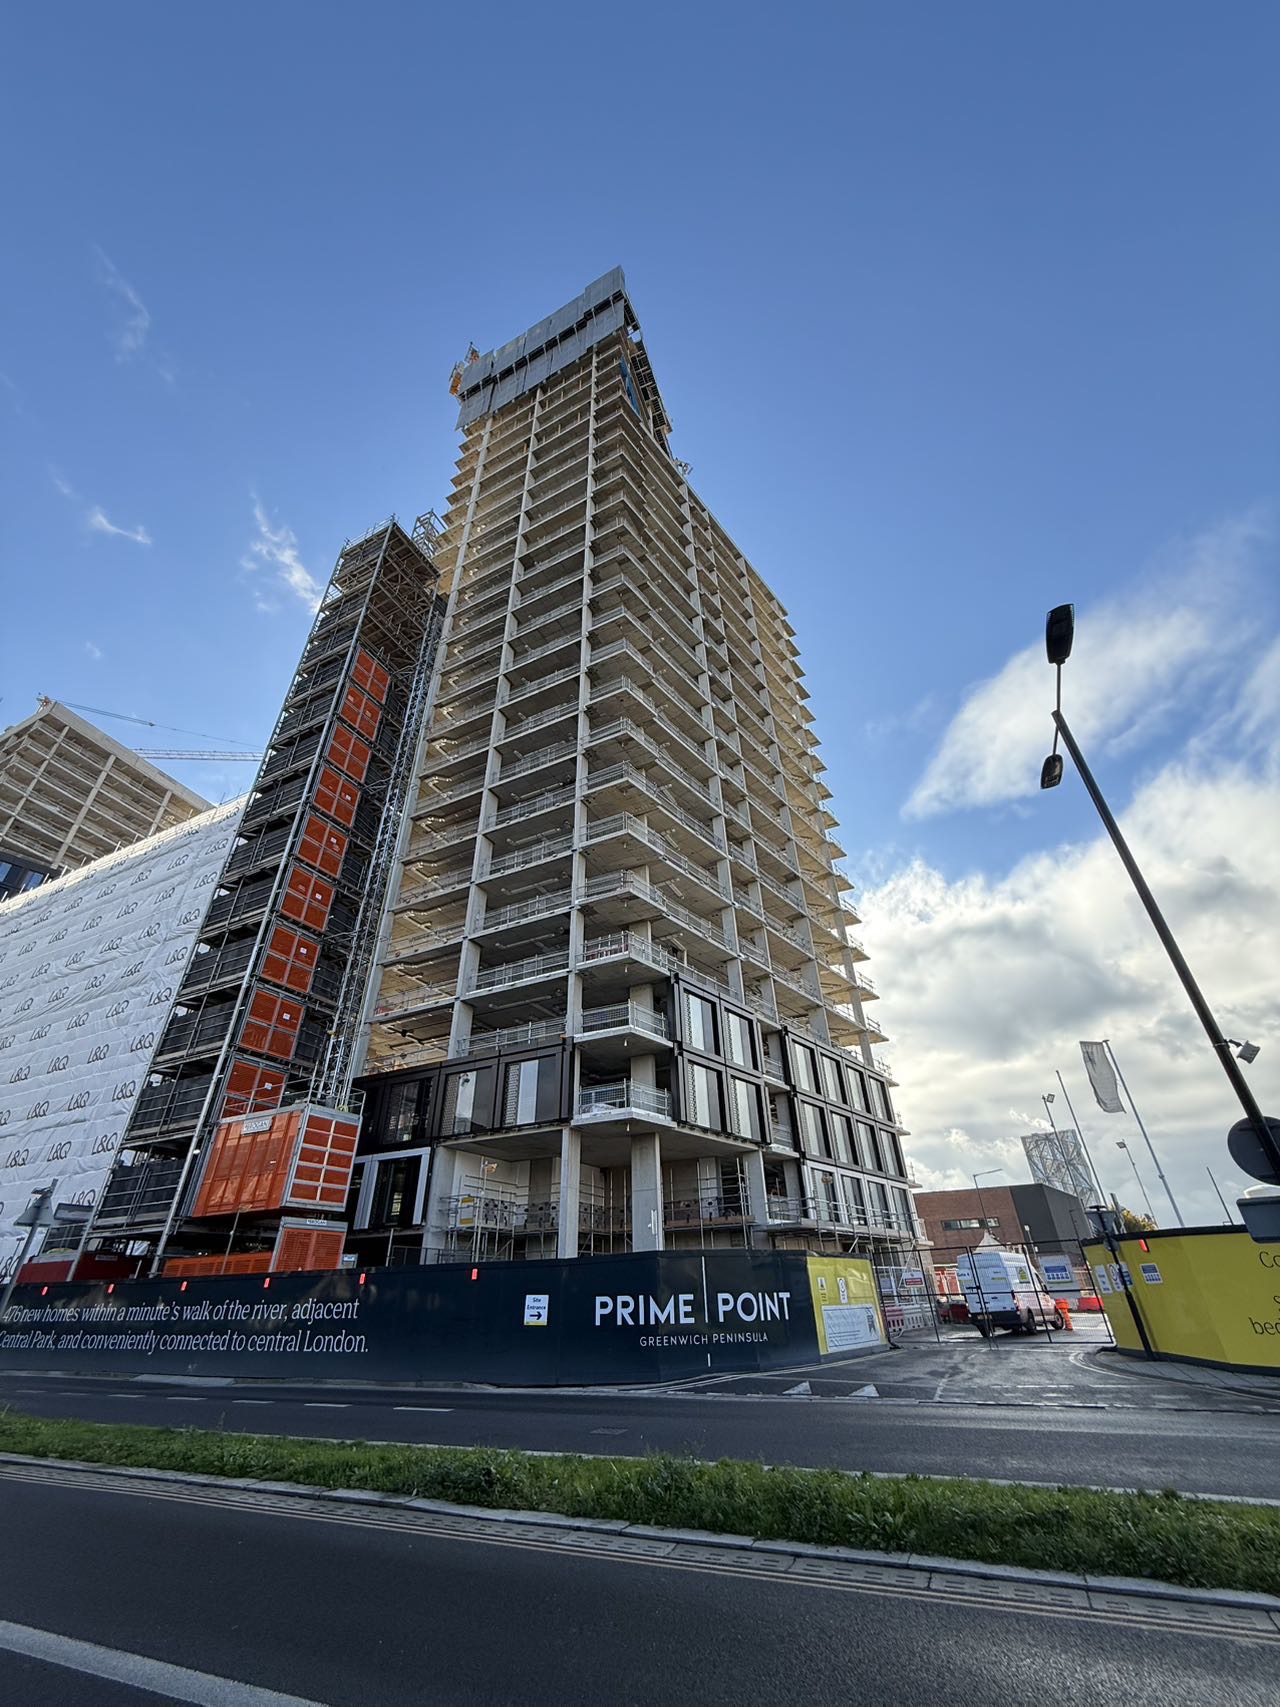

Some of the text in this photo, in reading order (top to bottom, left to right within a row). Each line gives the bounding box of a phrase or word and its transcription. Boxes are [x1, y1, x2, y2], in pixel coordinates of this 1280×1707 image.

[205, 838, 229, 855] L&Q
[167, 854, 189, 870] L&Q
[193, 871, 218, 889] L&Q
[116, 902, 138, 919] L&Q
[177, 908, 200, 927] L&Q
[138, 922, 160, 940] L&Q
[99, 937, 122, 954] L&Q
[164, 946, 188, 966] L&Q
[85, 974, 106, 990] L&Q
[147, 987, 172, 1007] L&Q
[106, 1000, 129, 1018] L&Q
[67, 1012, 89, 1030] L&Q
[29, 1023, 51, 1041] L&Q
[130, 1032, 155, 1054] L&Q
[87, 1044, 110, 1064] L&Q
[47, 1055, 69, 1074] L&Q
[9, 1066, 30, 1083] L&Q
[112, 1079, 136, 1102] L&Q
[27, 1100, 49, 1120] L&Q
[67, 1090, 90, 1111] L&Q
[47, 1141, 72, 1162] L&Q
[91, 1132, 118, 1155] L&Q
[5, 1149, 29, 1168] L&Q
[71, 1189, 96, 1206] L&Q
[21, 1309, 43, 1321] new
[42, 1304, 80, 1321] homes
[80, 1303, 117, 1321] within
[117, 1306, 126, 1321] a
[182, 1300, 212, 1320] walk
[212, 1299, 230, 1320] of
[228, 1299, 251, 1320] the
[251, 1299, 288, 1322] river,
[291, 1298, 360, 1325] adjacent
[595, 1294, 695, 1326] PRIME
[717, 1291, 791, 1323] POINT
[0, 1329, 369, 1355] Central Park, and conveniently connected to central London.
[639, 1332, 769, 1348] GREENWICH PENINSULA
